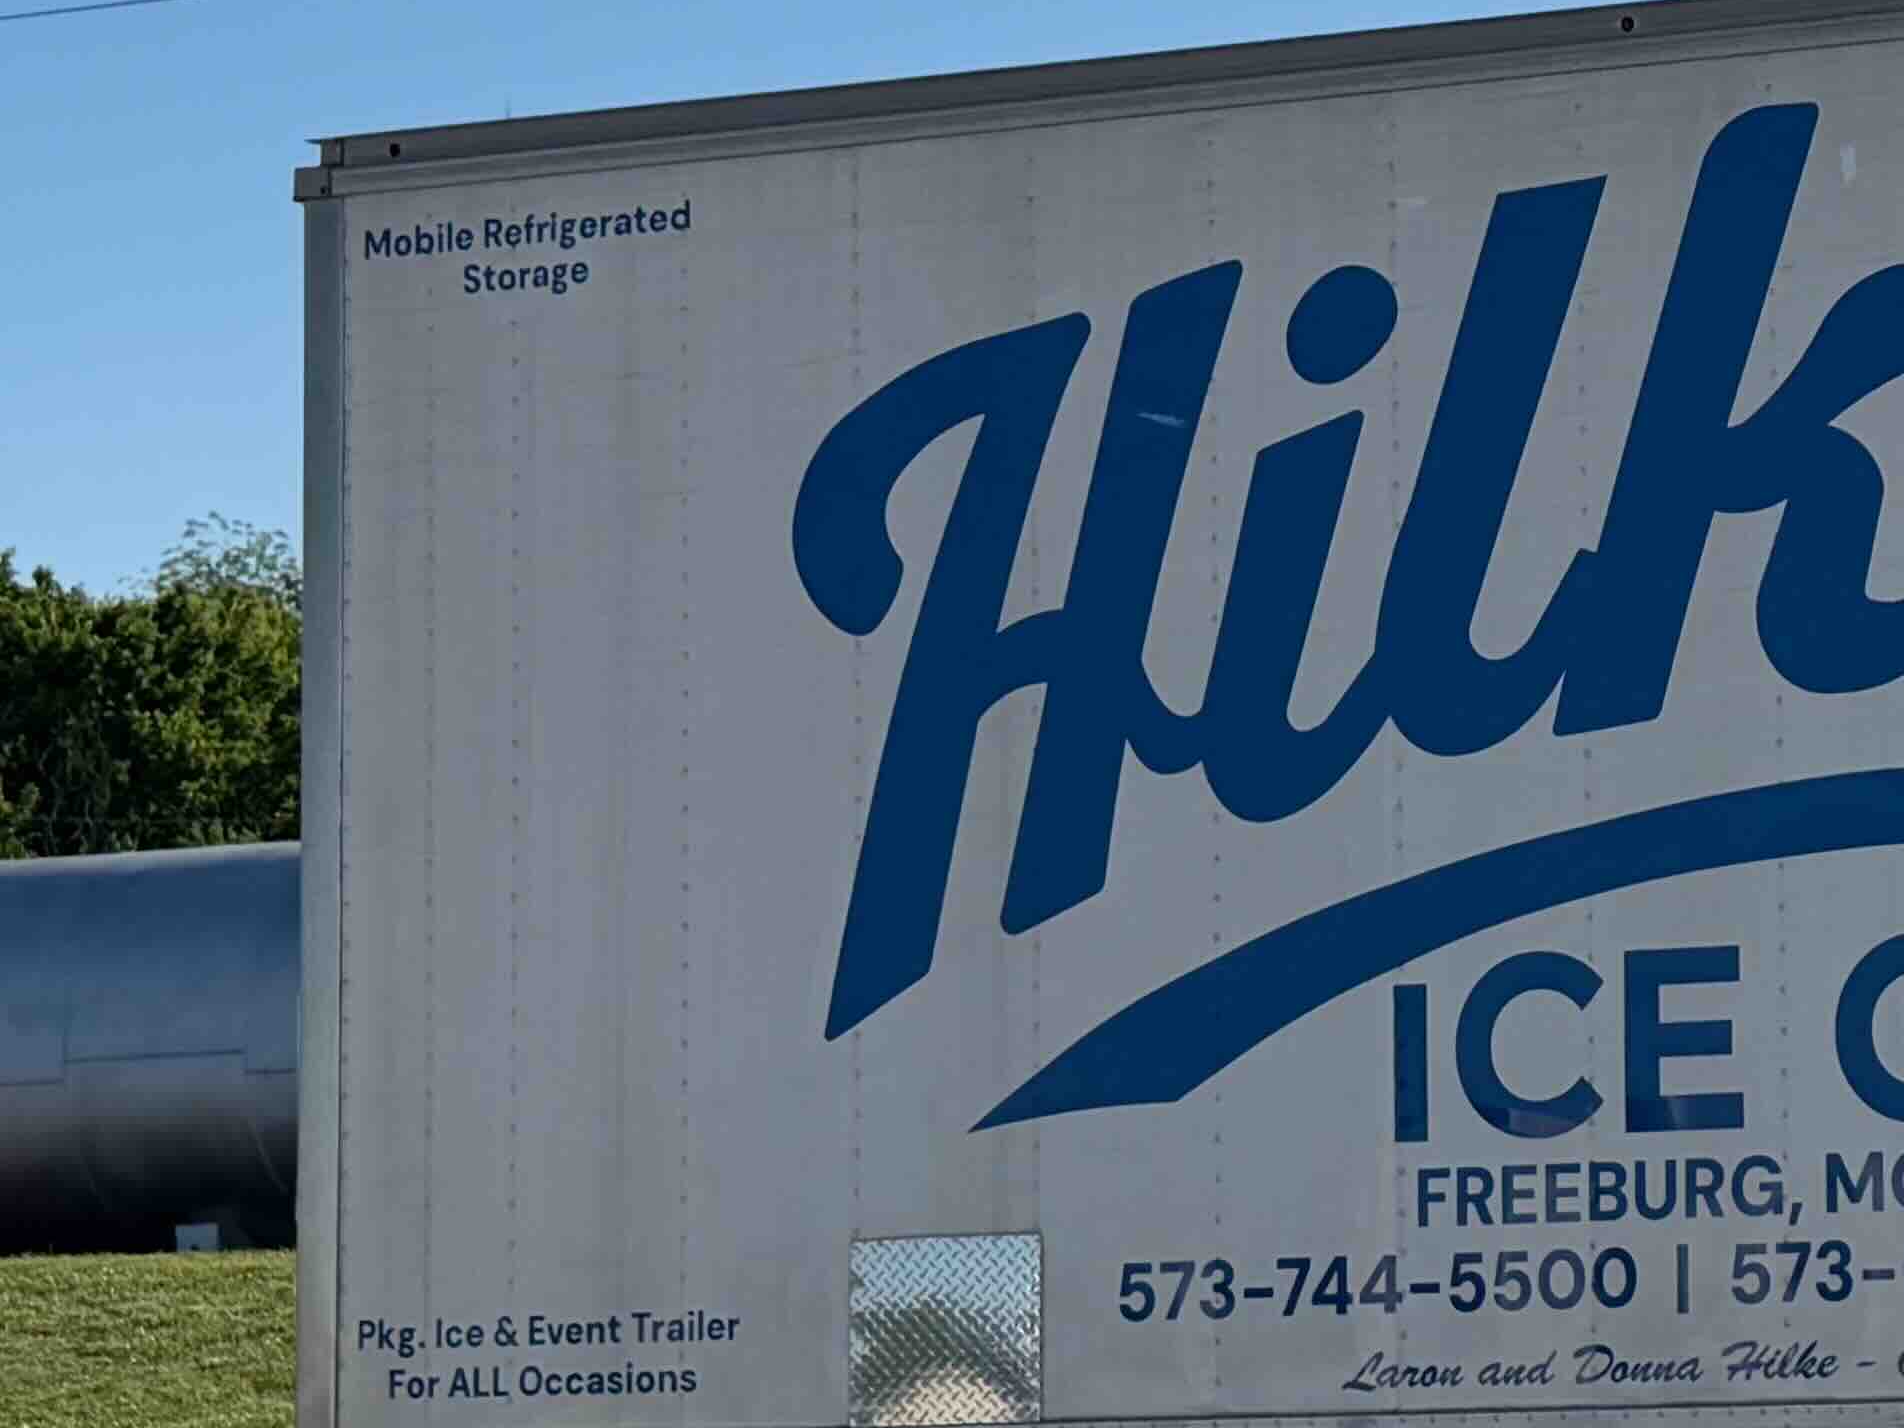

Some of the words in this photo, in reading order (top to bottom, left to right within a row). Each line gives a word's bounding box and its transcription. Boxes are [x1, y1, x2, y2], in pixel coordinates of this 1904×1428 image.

[364, 221, 474, 259] Mobile
[484, 199, 691, 249] Refrigerated
[464, 261, 589, 294] Storage
[1392, 945, 1745, 1143] ICE
[1417, 1155, 1802, 1227] FREEBURG,
[1118, 1247, 1638, 1322] 573-744-5500
[357, 1318, 426, 1357] Pkg.
[436, 1318, 484, 1348] Ice
[493, 1316, 519, 1347] &
[529, 1314, 621, 1345] Event
[630, 1310, 740, 1343] Trailer
[388, 1368, 440, 1400] For
[448, 1366, 509, 1398] ALL
[519, 1362, 697, 1397] Occasions
[1342, 1351, 1460, 1393] Laron
[1477, 1349, 1556, 1386] and
[1573, 1344, 1703, 1385] Donna
[1720, 1340, 1838, 1381] Hilke
